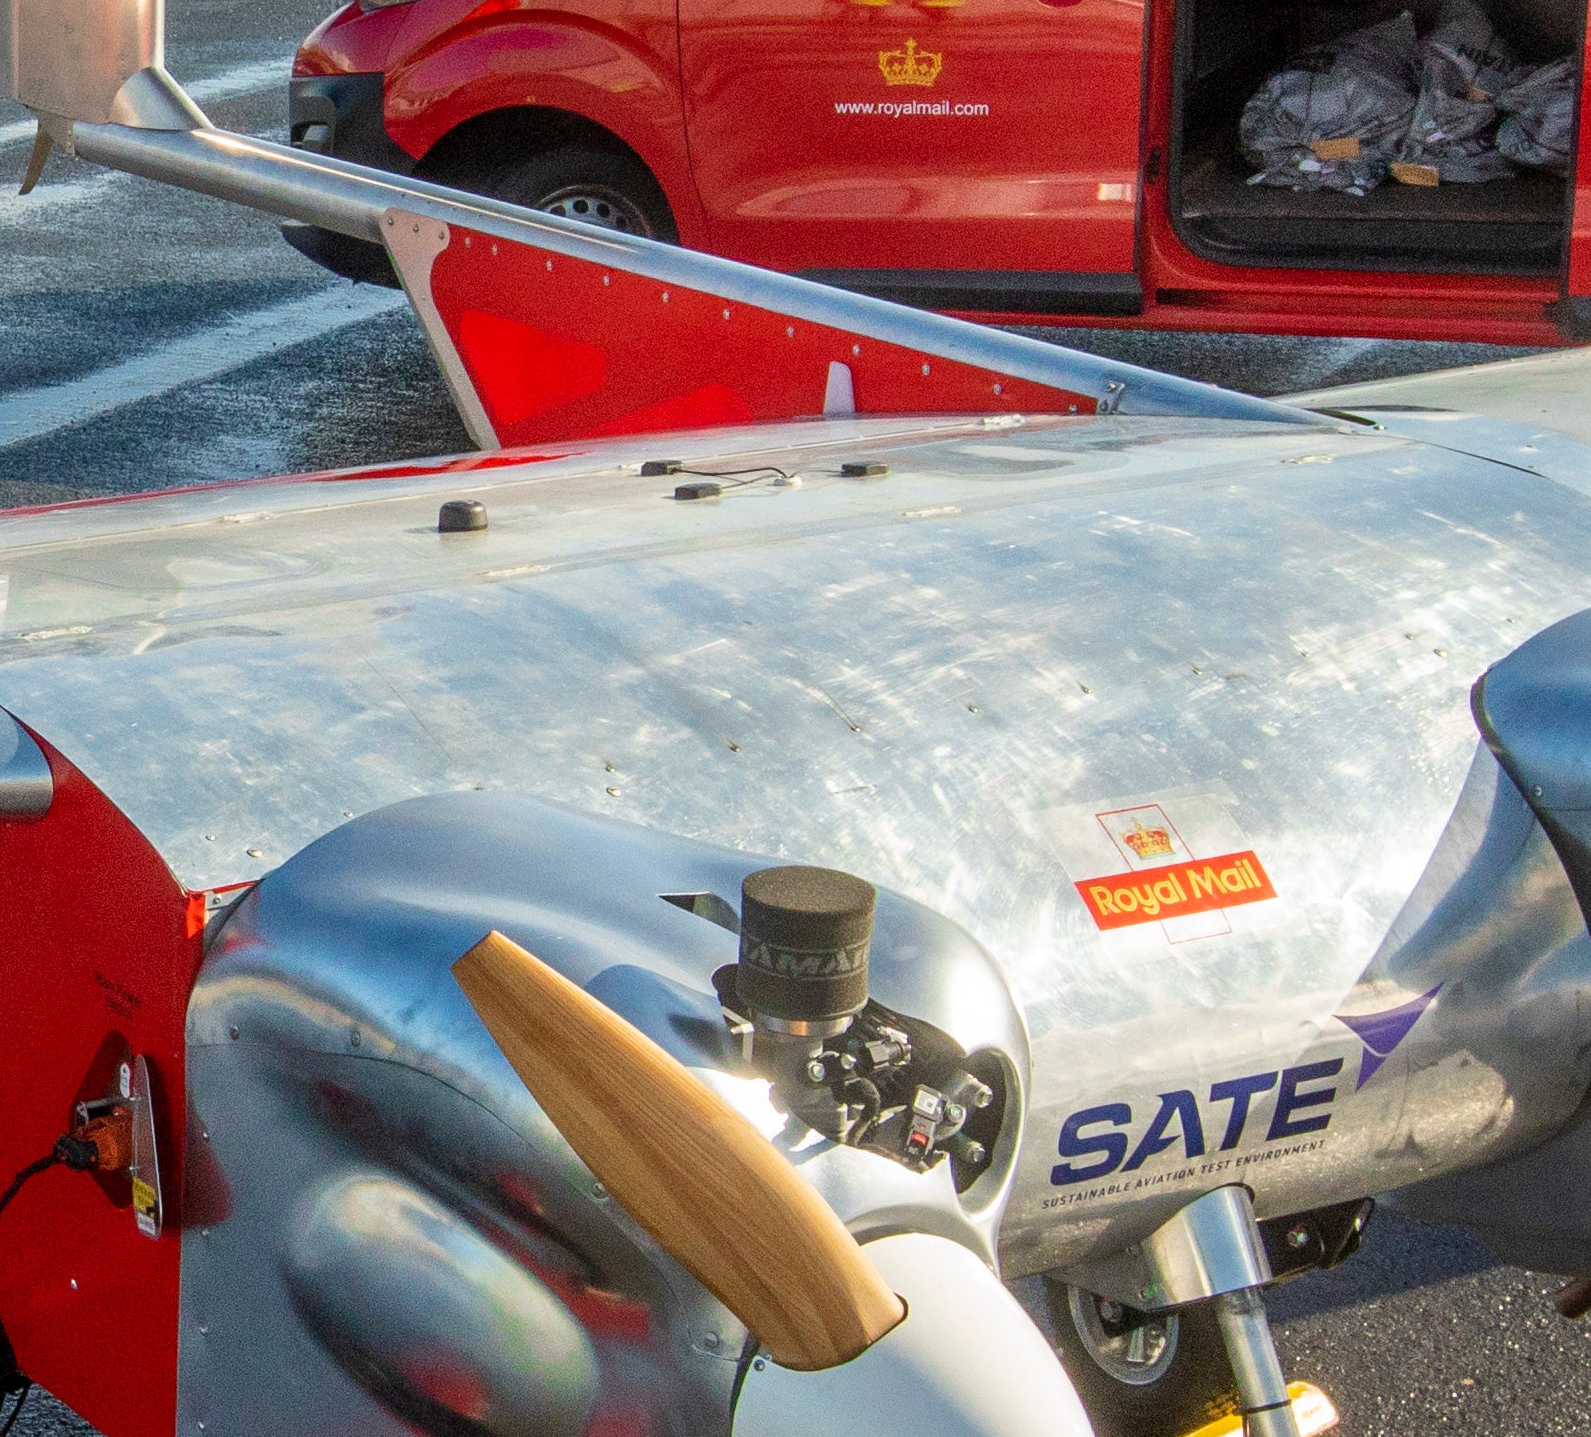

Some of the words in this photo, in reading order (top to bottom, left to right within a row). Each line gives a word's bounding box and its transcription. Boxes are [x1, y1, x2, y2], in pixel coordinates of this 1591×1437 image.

[834, 99, 990, 119] www.royalmail.com
[1089, 873, 1188, 916] Royal
[1186, 858, 1262, 900] Mail
[1050, 1057, 1345, 1187] SATE
[1042, 1181, 1132, 1210] SUSTAINABLE
[1134, 1167, 1196, 1190] AVIATION
[1199, 1158, 1231, 1175] TEST
[1236, 1139, 1326, 1167] ENVIRONMENT
